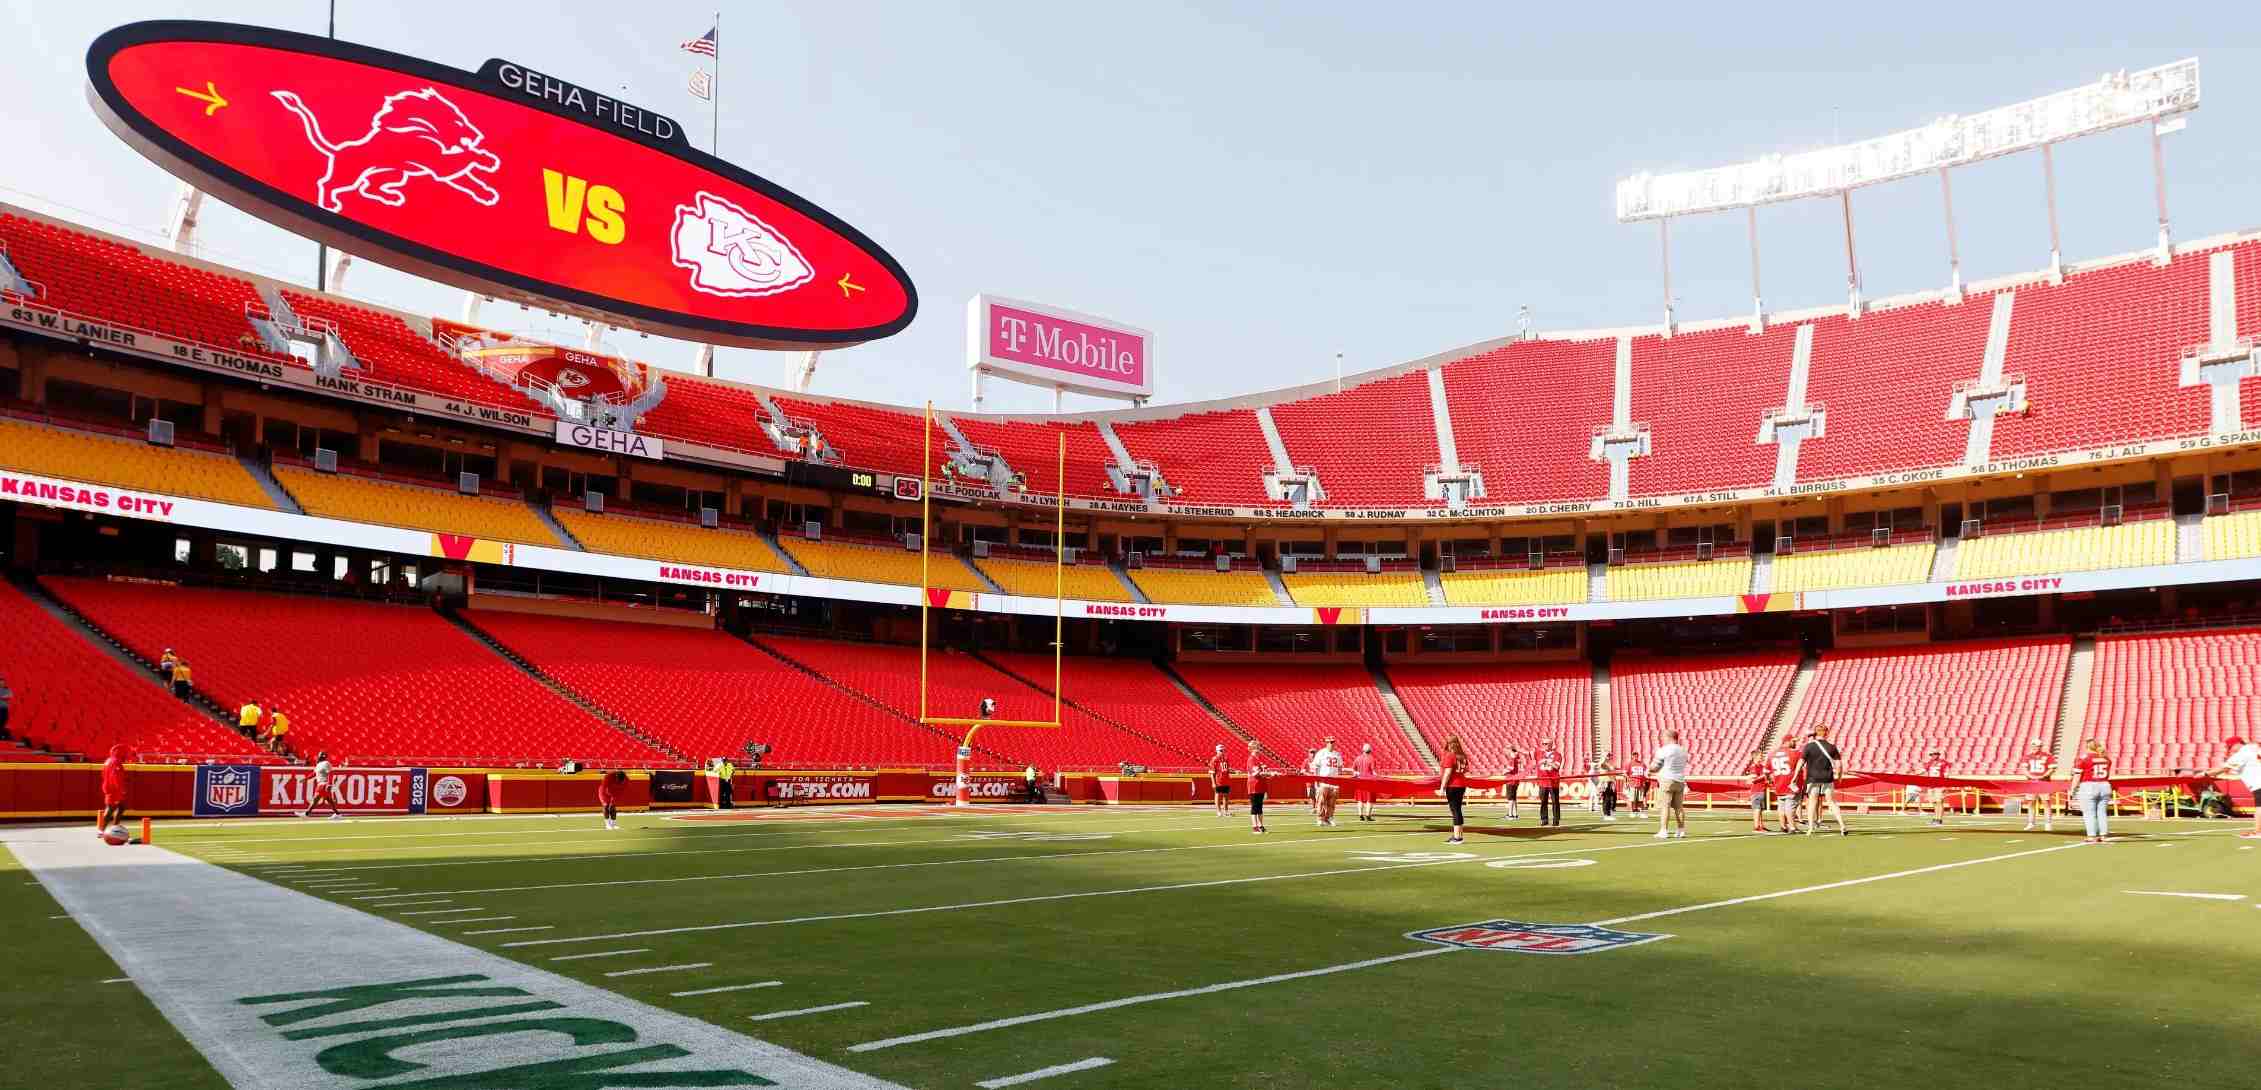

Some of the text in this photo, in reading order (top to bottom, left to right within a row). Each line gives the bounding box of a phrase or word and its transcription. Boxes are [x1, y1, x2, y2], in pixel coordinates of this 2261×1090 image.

[498, 64, 674, 139] GEHA FIELD
[542, 168, 626, 245] VS
[11, 307, 136, 348] 63 W. LANIER
[1032, 322, 1136, 376] Mobile
[172, 344, 284, 379] 18 E. THOMAS
[565, 351, 600, 366] GEHA
[315, 374, 416, 406] HANK STRAM
[445, 402, 531, 427] 44 J. WILSON
[571, 425, 649, 457] GEHA
[2179, 440, 2196, 450] 59
[2199, 437, 2216, 448] G.
[2104, 448, 2116, 459] J.
[2122, 444, 2147, 456] ALT
[1987, 462, 2000, 473] D.
[2001, 456, 2060, 472] THOMAS
[852, 472, 872, 487] 0:00
[1872, 469, 1945, 486] 35 C. OKOYE
[899, 480, 917, 497] 25
[955, 488, 1001, 500] PODOLAK
[1695, 494, 1705, 503] A.
[1710, 490, 1740, 502] STILL
[1777, 486, 1788, 496] L.
[1789, 481, 1848, 495] BURRUSS
[1, 477, 175, 517] KANSAS CITY
[1031, 496, 1039, 504] J.
[1626, 500, 1636, 508] D.
[1637, 497, 1661, 507] HILL
[1101, 502, 1110, 510] A.
[1111, 503, 1149, 513] HAYNES
[1184, 507, 1235, 516] STENERUD
[1265, 510, 1275, 518] S.
[1276, 510, 1325, 518] HEADRICK
[1357, 511, 1367, 519] J.
[1438, 509, 1448, 518] C.
[1449, 508, 1505, 518] McCLINTON
[1526, 503, 1592, 514] 20 D. CHERRY
[659, 566, 760, 588] KANSAS CITY
[1946, 577, 2063, 597] KANSAS CITY
[1086, 604, 1167, 618] KANSAS CITY
[1481, 607, 1569, 620] KANSAS CITY
[1326, 756, 1338, 768] 32
[1771, 756, 1791, 777] 95
[2028, 758, 2046, 774] 15
[2093, 763, 2109, 779] 15
[211, 785, 246, 803] NFL
[412, 775, 424, 805] 2023
[1425, 927, 1594, 952] NFL
